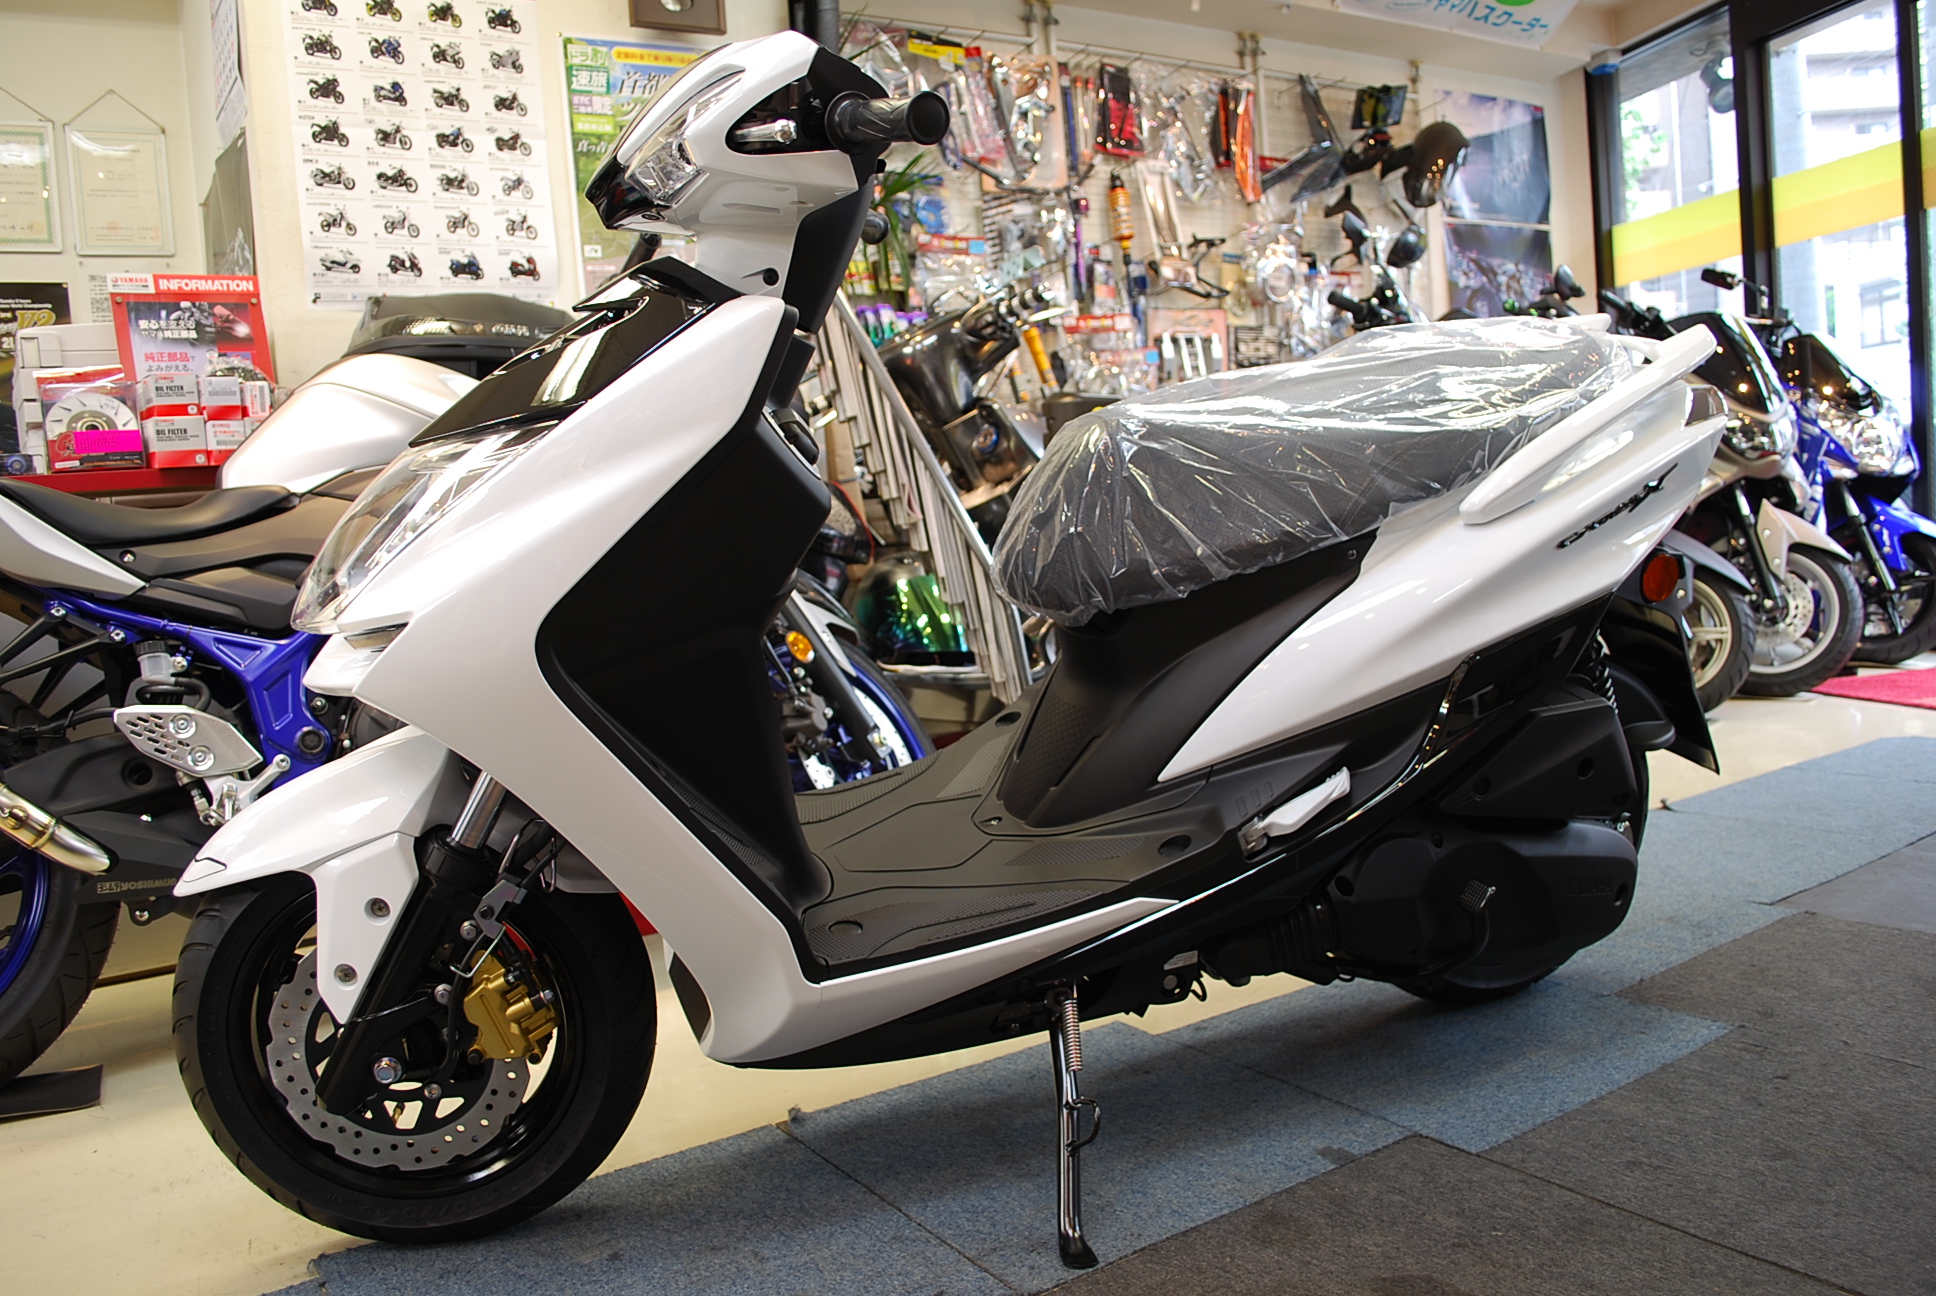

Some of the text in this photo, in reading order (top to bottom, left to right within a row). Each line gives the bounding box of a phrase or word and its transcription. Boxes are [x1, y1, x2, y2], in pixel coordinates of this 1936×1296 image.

[573, 96, 591, 105] ETC
[119, 276, 149, 284] YAMAHA
[158, 279, 254, 291] INFORMATION
[155, 428, 166, 436] OIL
